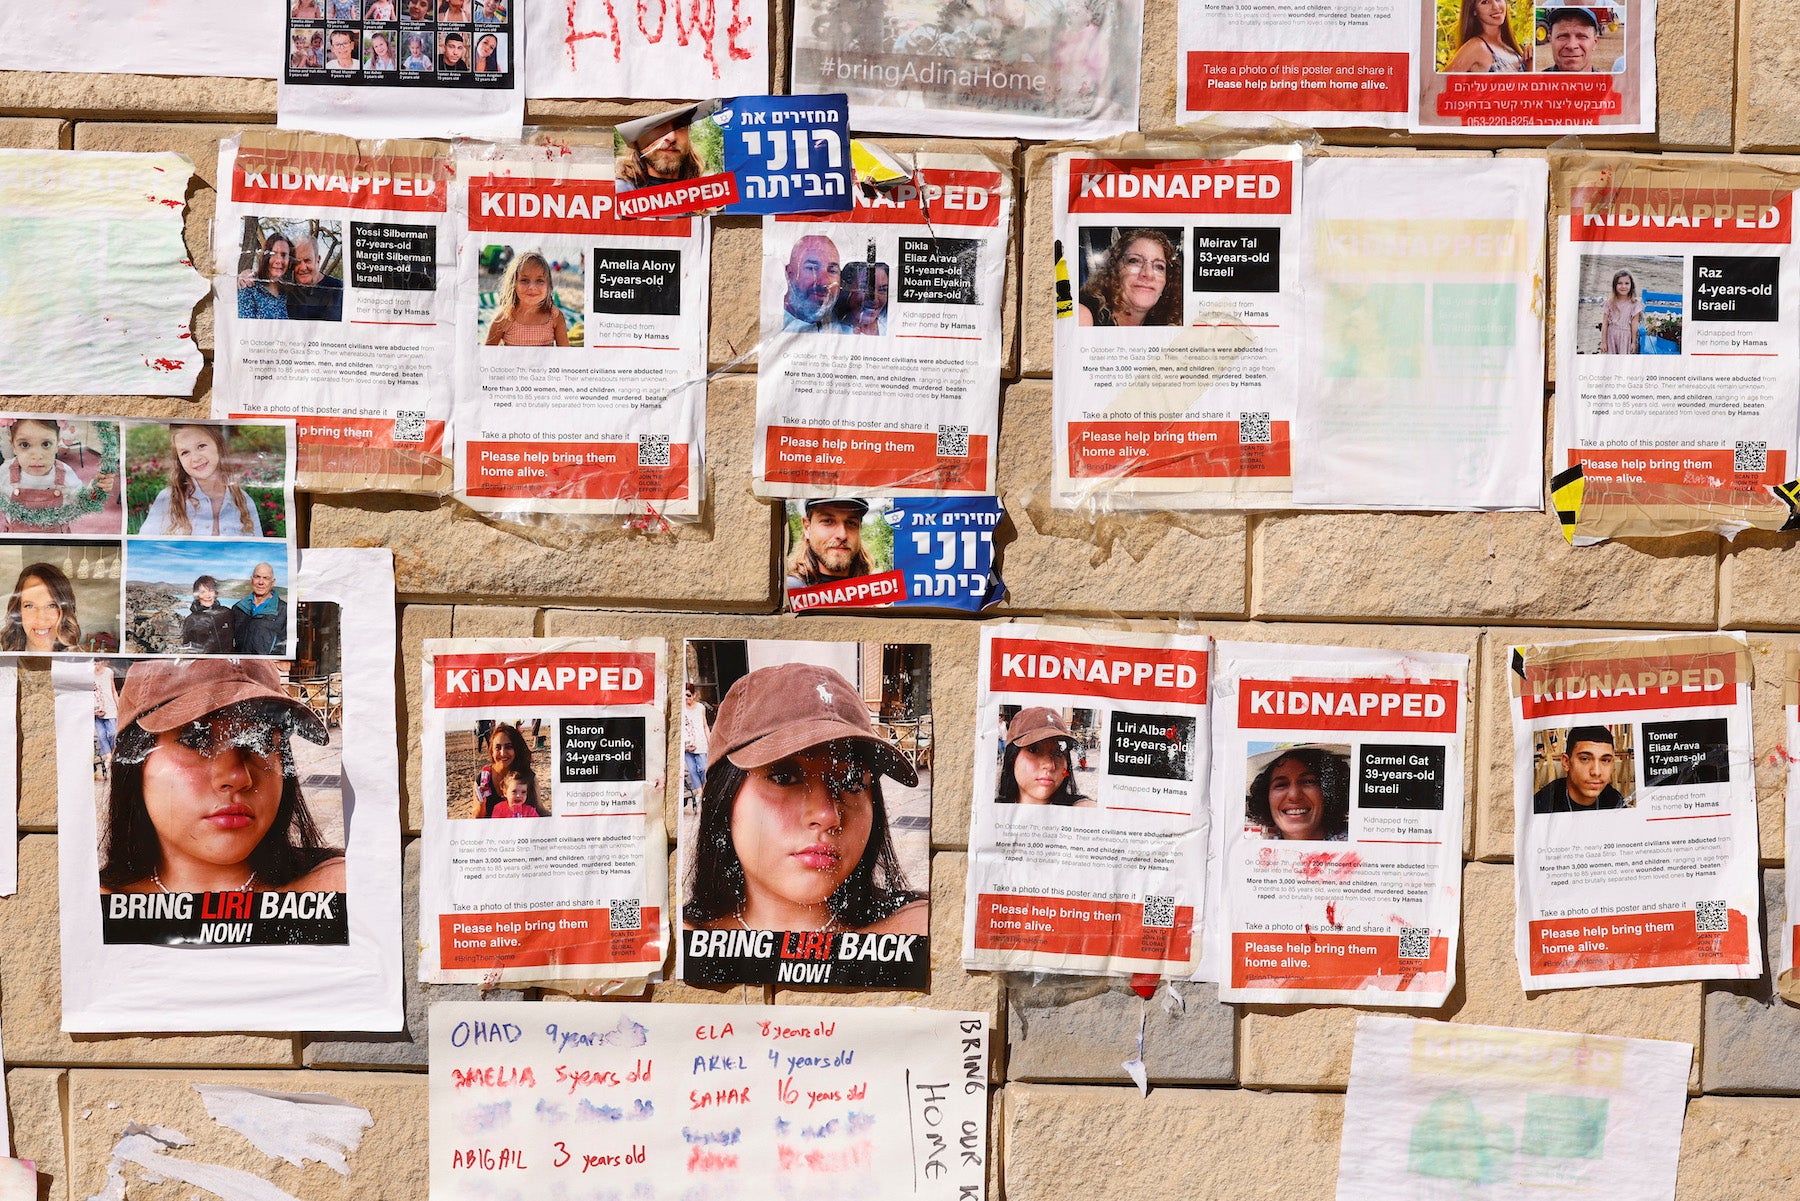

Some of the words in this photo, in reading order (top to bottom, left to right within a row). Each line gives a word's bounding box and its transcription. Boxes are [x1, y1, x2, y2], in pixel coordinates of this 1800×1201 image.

[820, 57, 1047, 91] #bringAdinaHome
[1204, 64, 1227, 74] Take
[1230, 66, 1236, 74] a
[1239, 64, 1267, 77] photo
[1270, 65, 1279, 74] of
[1282, 65, 1299, 74] this
[1302, 66, 1332, 77] poster
[1336, 65, 1354, 74] and
[1357, 65, 1384, 74] share
[1388, 66, 1393, 74] it
[1207, 80, 1242, 88] Please
[1245, 80, 1267, 90] help
[1270, 80, 1298, 90] bring
[1301, 80, 1326, 89] them
[1329, 81, 1358, 89] home
[1361, 81, 1389, 89] alive.
[1454, 81, 1488, 92] עליהם
[1490, 83, 1515, 91] שמע
[1531, 83, 1559, 91] אותם
[1561, 82, 1594, 91] שראה
[1596, 83, 1606, 91] מי
[1496, 101, 1517, 110] קשר
[1547, 99, 1572, 109] ליצור
[741, 111, 766, 125] את
[772, 109, 839, 124] מחזירים
[743, 129, 841, 172] רוני
[243, 164, 436, 198] KIDNAPPED
[746, 172, 844, 199] הביתה
[1080, 174, 1281, 199] KIDNAPPED
[619, 181, 731, 216] KIDNAPPED!
[1583, 202, 1781, 229] KIDNAPPED
[356, 227, 380, 239] Yossi
[382, 228, 428, 240] Silberman
[356, 239, 412, 251] 67-years-old
[905, 242, 928, 250] Dikla
[1199, 238, 1237, 248] Meirav
[1241, 238, 1257, 248] Tal
[356, 250, 382, 262] Margit
[384, 252, 432, 264] Silberman
[905, 254, 927, 262] Eliaz
[929, 255, 957, 263] Arava
[1199, 252, 1270, 264] 53-years-old
[356, 262, 411, 274] 63-years-old
[600, 259, 639, 271] Amelia
[642, 260, 675, 273] Alony
[904, 266, 962, 275] 51-years-old
[1199, 267, 1234, 277] Israeli
[356, 273, 383, 283] Israeli
[1699, 268, 1722, 278] Raz
[600, 274, 664, 286] 5-years-old
[904, 278, 931, 286] Noam
[934, 278, 971, 288] Elyakim
[600, 288, 635, 300] Israeli
[904, 290, 961, 299] 47-years-old
[1698, 284, 1772, 297] 4-years-old
[1698, 300, 1736, 311] Israeli
[1580, 439, 1598, 447] Take
[1607, 439, 1628, 449] photo
[1630, 439, 1637, 447] of
[1639, 439, 1653, 447] this
[1655, 440, 1678, 448] poster
[1680, 439, 1695, 447] and
[1697, 439, 1718, 447] share
[481, 451, 521, 463] Please
[524, 451, 549, 465] help
[552, 452, 583, 465] bring
[586, 452, 616, 463] them
[481, 466, 510, 477] home
[513, 466, 548, 477] alive.
[912, 513, 936, 526] את
[914, 574, 990, 596] ביתה
[790, 578, 898, 609] KIDNAPPED!
[1001, 653, 1197, 688] KIDNAPPED
[446, 667, 644, 693] KIDNAPPED
[1533, 668, 1725, 704] KIDNAPPED
[1250, 690, 1446, 717] KIDNAPPED
[566, 725, 604, 735] Sharon
[1117, 722, 1136, 733] Liri
[1648, 731, 1677, 740] Tomer
[566, 738, 597, 750] Alony
[600, 738, 634, 749] Cunio,
[1116, 737, 1188, 752] 18-years-old
[1649, 742, 1671, 752] Eliaz
[1673, 741, 1700, 750] Arava
[566, 751, 631, 763] 34-years-old
[1115, 752, 1151, 764] Israeli
[1366, 754, 1407, 765] Carmel
[1409, 756, 1429, 765] Gat
[1649, 752, 1705, 764] 17-years-old
[566, 766, 598, 775] Israeli
[1365, 770, 1435, 781] 39-years-old
[1650, 765, 1678, 775] Israeli
[1365, 784, 1399, 794] Israeli
[1695, 800, 1719, 808] Hamas
[109, 893, 193, 920] BRING
[201, 892, 253, 920] LIRI
[260, 892, 335, 920] BACK
[453, 923, 492, 934] Please
[496, 922, 522, 934] help
[525, 920, 555, 933] bring
[558, 919, 588, 929] them
[200, 923, 253, 943] NOW!
[454, 938, 487, 948] home
[490, 937, 521, 947] alive.
[689, 930, 773, 958] BRING
[780, 931, 832, 960] LIRI
[838, 933, 916, 962] BACK
[778, 963, 831, 983] NOW!
[452, 1021, 521, 1047] OHAD
[696, 1023, 734, 1040] ELA
[768, 1050, 779, 1067] 4
[960, 1020, 985, 1095] BRING
[690, 1087, 750, 1110] SAHAR
[778, 1077, 798, 1104] 16
[807, 1090, 842, 1109] years
[916, 1083, 949, 1179] HOME
[960, 1121, 982, 1166] OUR
[453, 1149, 527, 1170] ABIGAIL
[554, 1142, 570, 1167] 3
[583, 1152, 620, 1173] years
[625, 1145, 645, 1164] old
